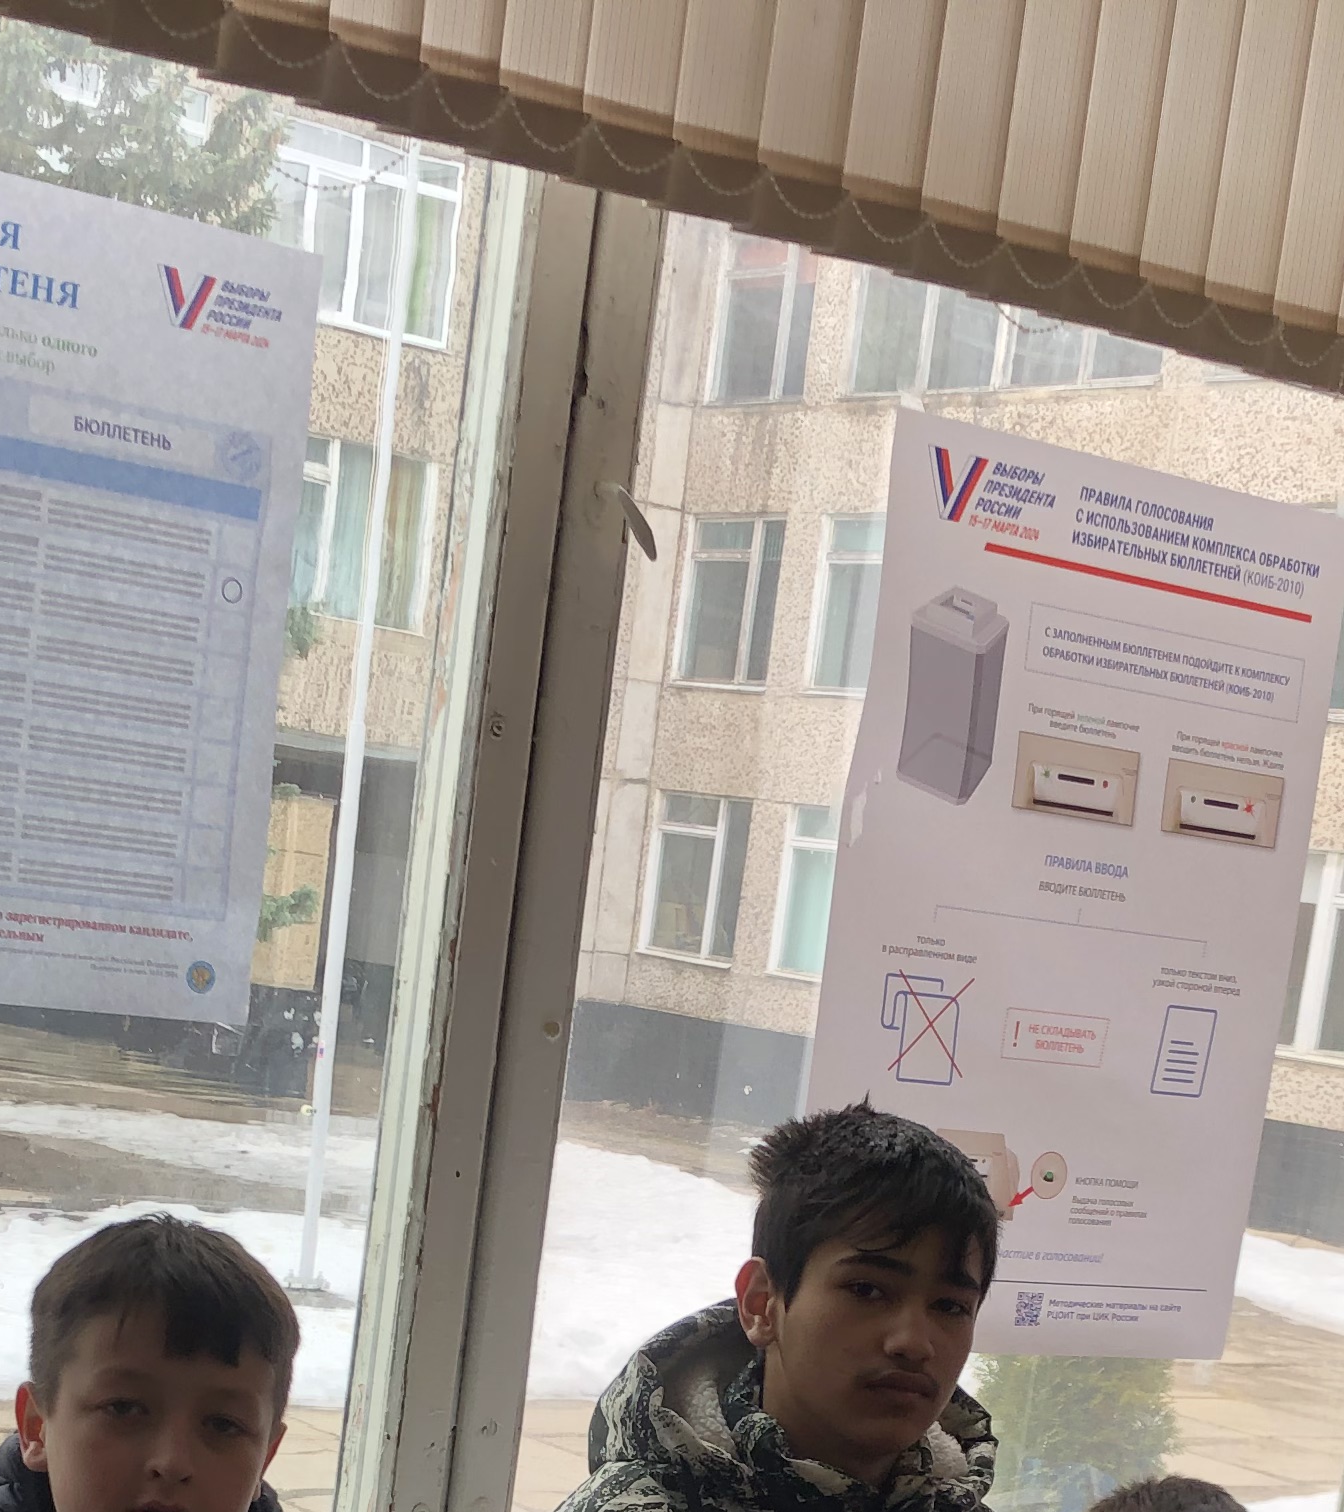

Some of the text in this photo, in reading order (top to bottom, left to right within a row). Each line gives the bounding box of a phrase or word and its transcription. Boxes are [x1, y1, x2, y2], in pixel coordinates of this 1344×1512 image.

[39, 331, 98, 360] одного
[71, 411, 172, 454] БЮЛЛЕТЕНЬ
[992, 460, 1046, 487] ВЫБОРЫ
[974, 496, 1023, 521] РОССИИ
[982, 478, 1056, 511] ПРЕЗИДЕНТА
[1078, 485, 1215, 532] ПРАВИЛА ГОЛОСОВАНИЯ
[1018, 525, 1041, 543] 2024
[1074, 507, 1321, 579] С ИСПОЛЬЗОВАНИЕМ КОМПЛЕКСА ОБРАБОТКИ
[1071, 529, 1306, 599] ИЗБИРАТЕЛЬНЫХ БЮЛЛЕТЕНЕЙ (КОИБ-2010)
[1041, 644, 1095, 667] ОБРАБОТКИ
[1095, 655, 1168, 681] ИЗБИРАТЕЛЬНЫХ
[1168, 669, 1225, 692] БЮЛЛЕТЕНЕЙ
[1043, 625, 1291, 687] С ЗАПОЛНЕННЫМ БЮЛЛЕТЕНЕМ ПОДОЙДИТЕ К КОМПЛЕКСУ
[1043, 853, 1130, 881] ПРАВИЛА ВВОДА
[1037, 879, 1127, 904] ВВОДИТЕ БЮЛЛЕТЕНЬ
[5, 907, 126, 937] зарегистрированном
[887, 944, 955, 964] расправленном
[955, 953, 978, 965] виде
[915, 934, 946, 948] только
[1027, 1022, 1097, 1042] НЕ СКЛАДЫВАТЬ
